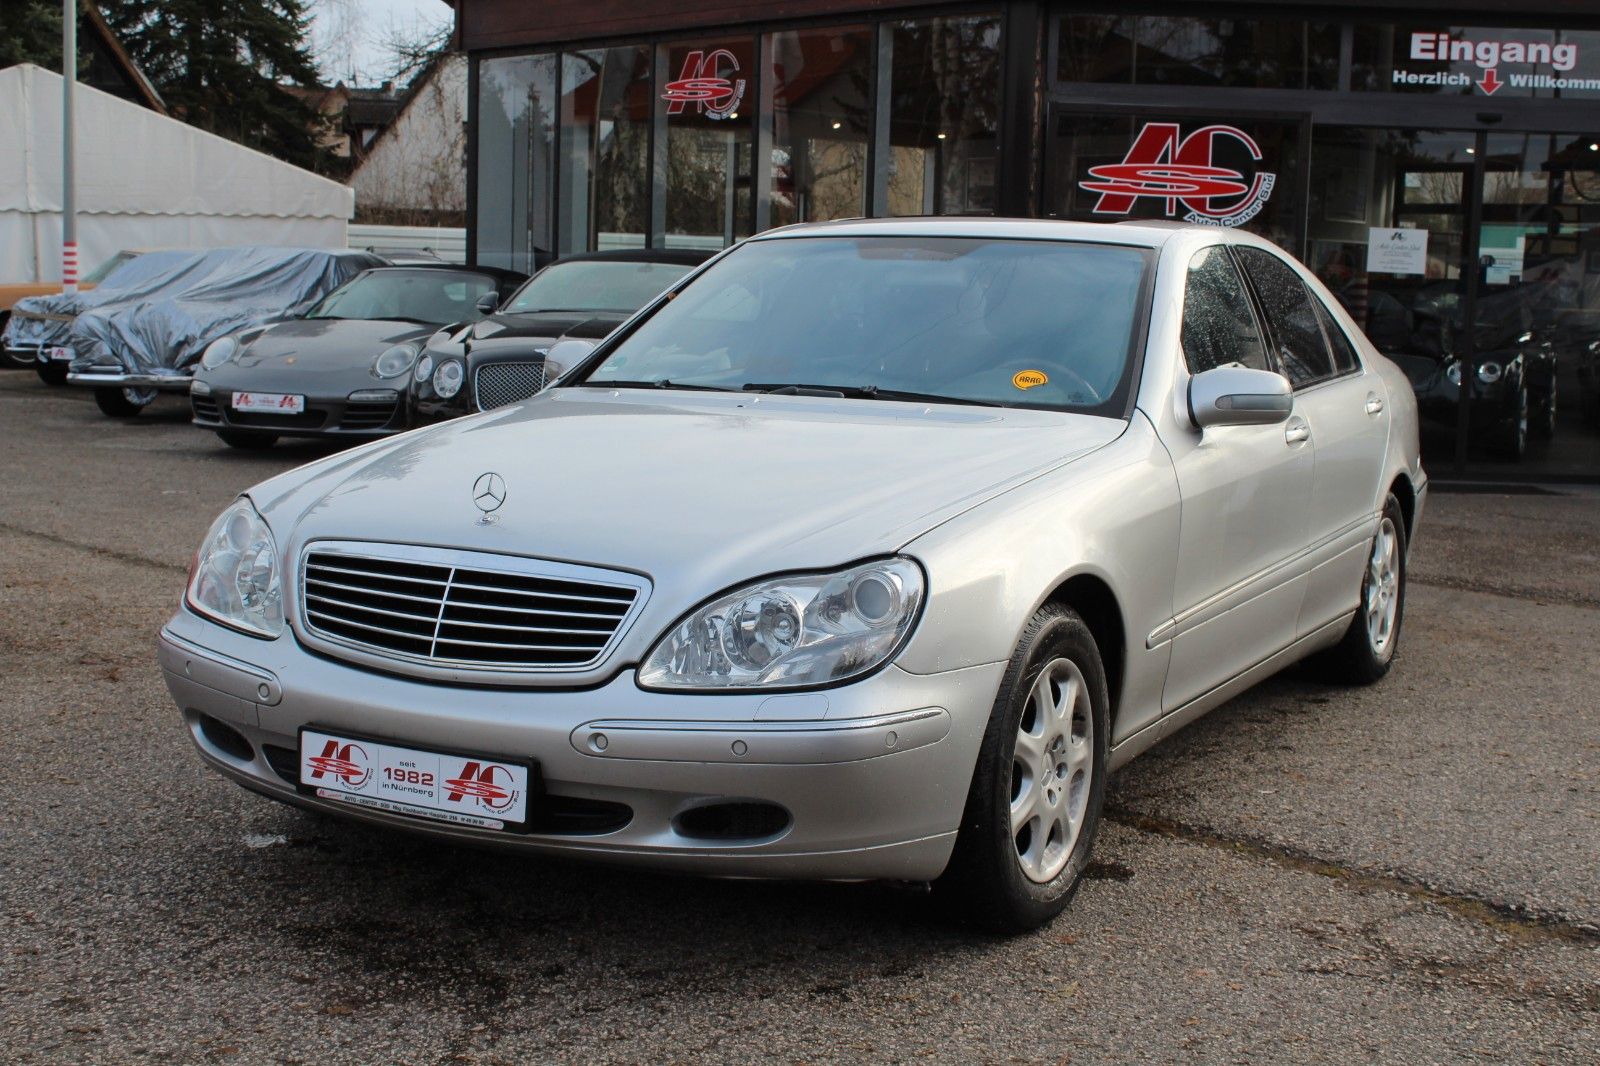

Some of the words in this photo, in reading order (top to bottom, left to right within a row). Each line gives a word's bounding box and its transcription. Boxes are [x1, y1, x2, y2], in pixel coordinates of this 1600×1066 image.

[1410, 32, 1577, 71] Eingang
[1392, 70, 1470, 86] Herzlich
[1509, 73, 1600, 89] Willkomm
[1185, 212, 1220, 227] Auto
[1221, 200, 1263, 227] Center
[384, 767, 434, 786] 1982
[391, 783, 434, 798] Nürnberg
